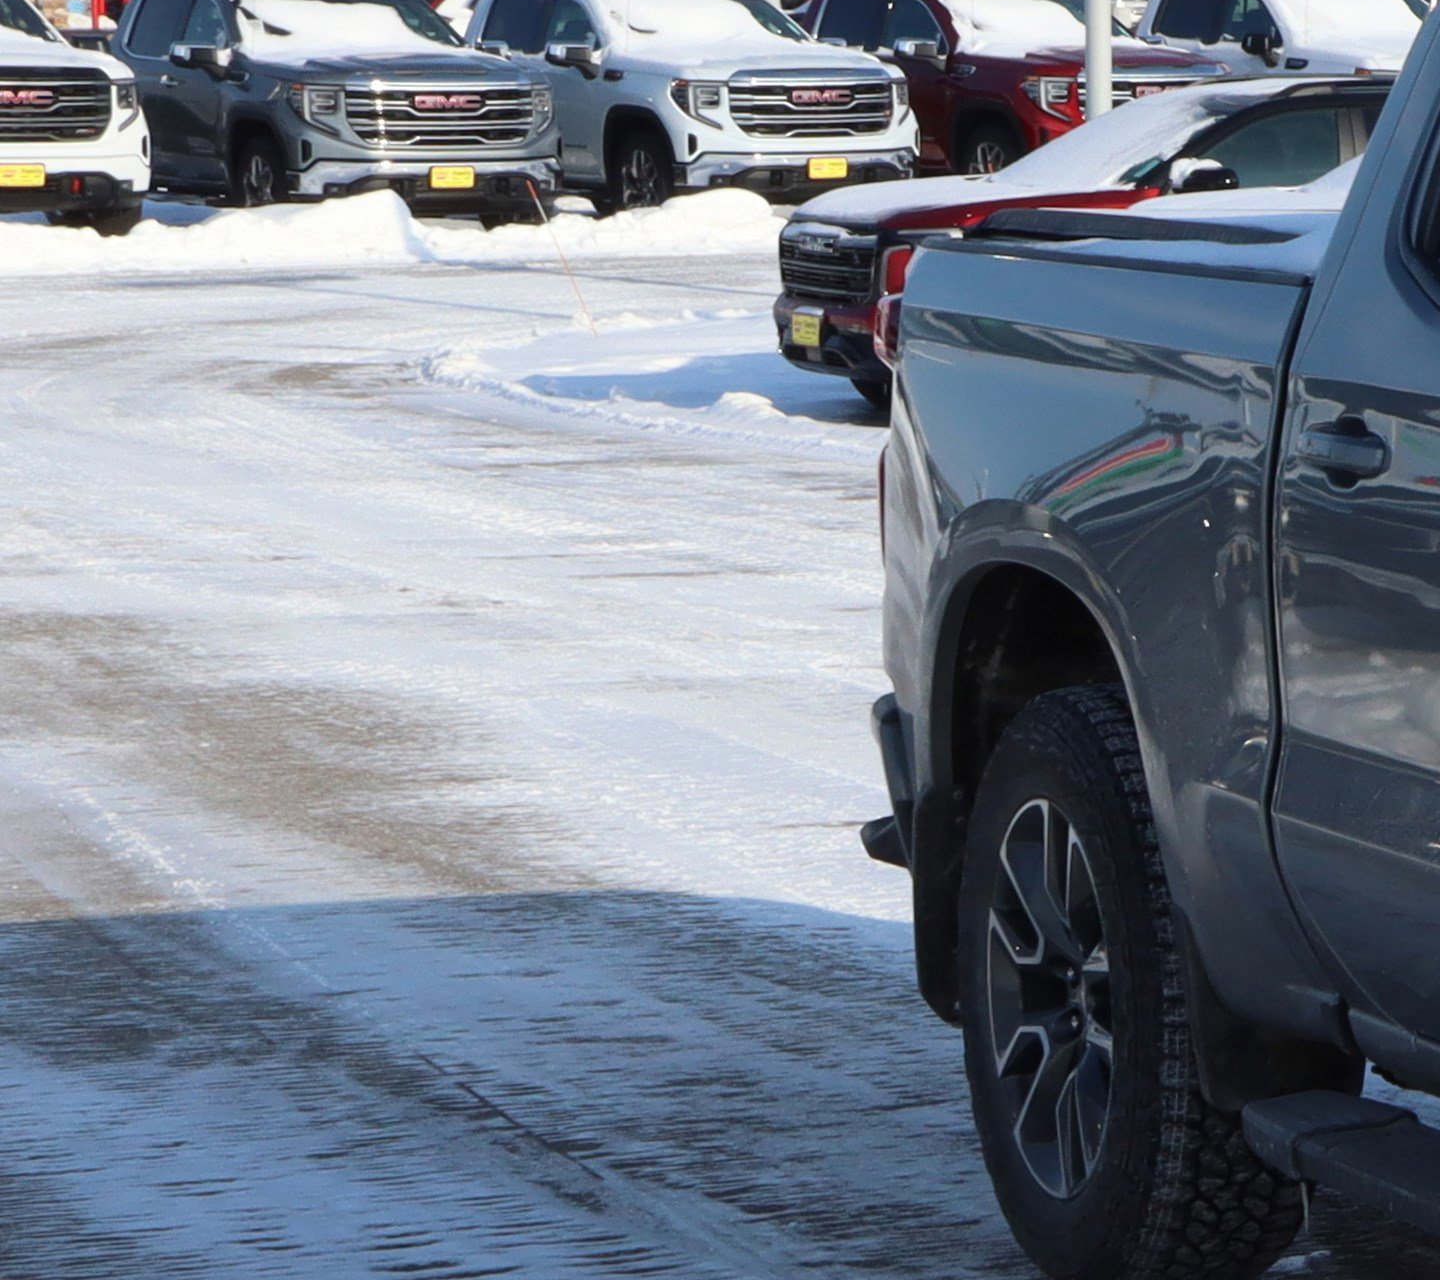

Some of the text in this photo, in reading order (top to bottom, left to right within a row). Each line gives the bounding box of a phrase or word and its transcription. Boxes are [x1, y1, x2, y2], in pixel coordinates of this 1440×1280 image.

[0, 90, 53, 104] MC
[414, 94, 482, 109] GMC
[792, 89, 852, 103] GMC
